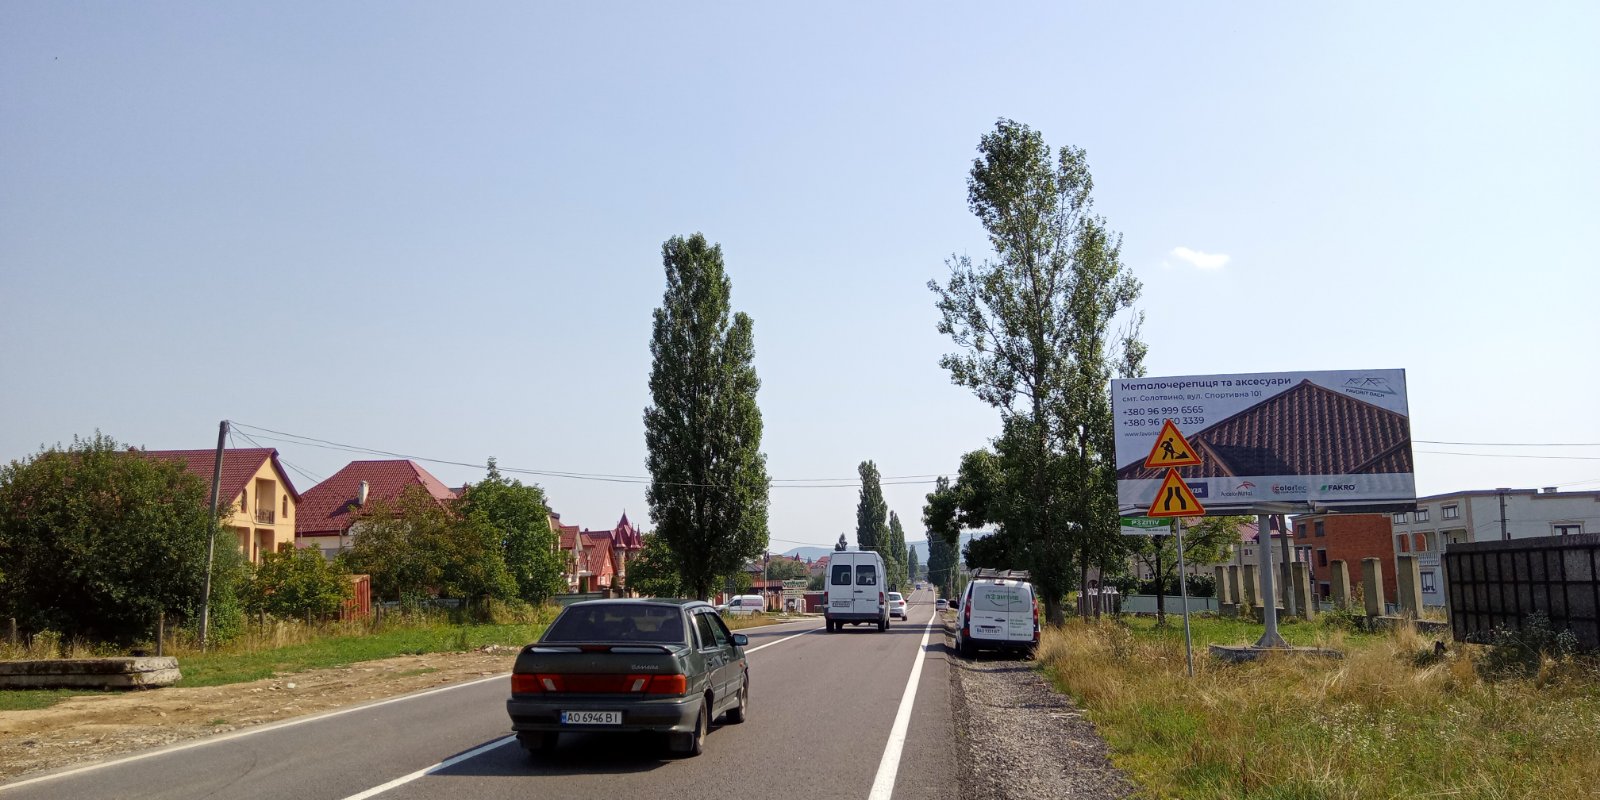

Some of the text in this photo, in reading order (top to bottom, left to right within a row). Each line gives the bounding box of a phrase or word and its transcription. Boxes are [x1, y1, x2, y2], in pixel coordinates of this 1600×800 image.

[1121, 380, 1218, 391] Металочерепиця
[1236, 378, 1291, 386] аксесуари
[1140, 394, 1184, 402] Солотвино,
[1204, 392, 1250, 400] Спортивна
[1122, 408, 1145, 416] +380
[1161, 406, 1179, 414] 999
[1181, 406, 1204, 414] 6565
[1123, 418, 1146, 426] +380
[1148, 418, 1160, 426] 96
[1182, 416, 1204, 424] 3339
[567, 713, 580, 722] AO
[582, 713, 604, 722] 6946
[606, 713, 617, 722] BI
